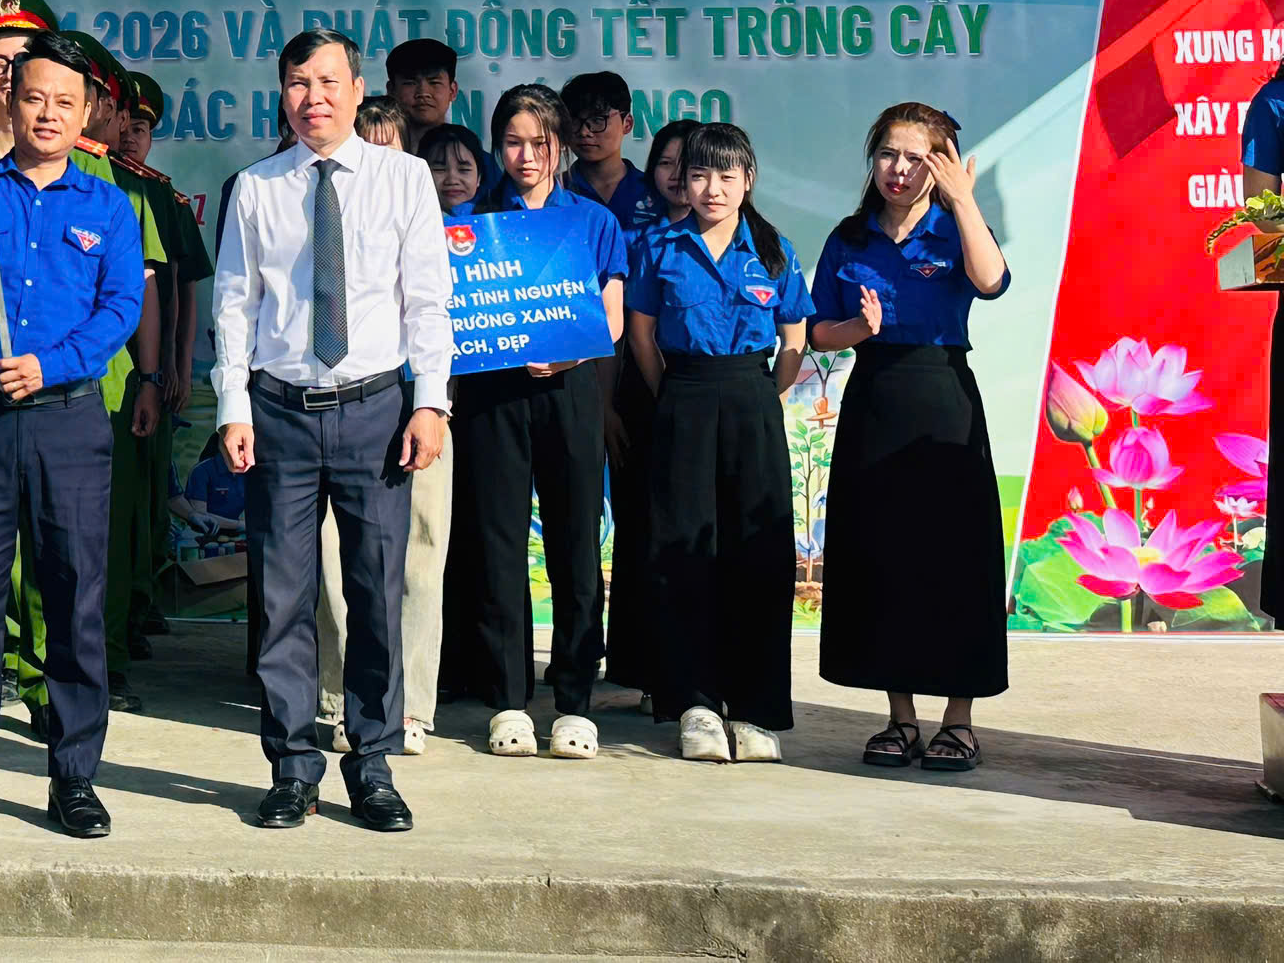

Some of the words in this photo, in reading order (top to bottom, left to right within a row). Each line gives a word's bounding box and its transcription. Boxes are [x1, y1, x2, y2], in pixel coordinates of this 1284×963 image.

[92, 11, 210, 61] 2026
[222, 0, 281, 60] VÀ
[1174, 30, 1255, 64] XUNG
[1174, 95, 1231, 135] XÂY
[464, 259, 523, 283] HÌNH
[469, 289, 511, 307] TÌNH
[514, 279, 586, 302] NGUYỆN
[452, 311, 517, 333] RƯỜNG
[520, 305, 578, 324] XANH,
[452, 337, 494, 360] ẠCH,
[496, 333, 531, 353] ĐẸP
